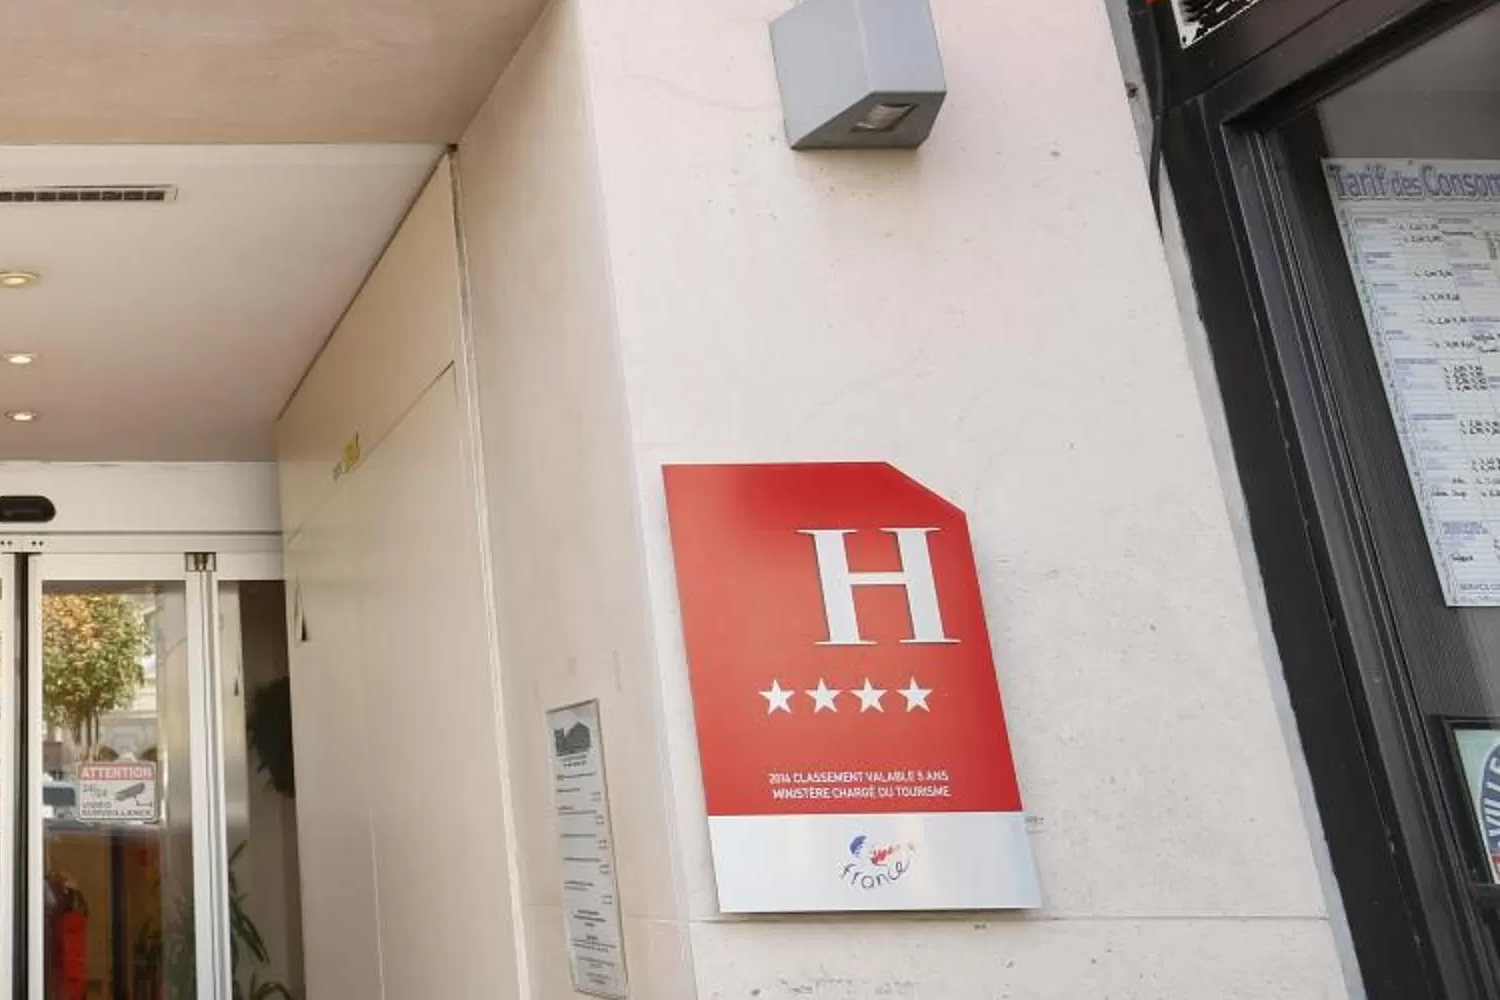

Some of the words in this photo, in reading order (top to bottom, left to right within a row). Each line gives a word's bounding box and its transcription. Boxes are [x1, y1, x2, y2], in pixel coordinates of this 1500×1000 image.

[796, 526, 961, 646] H
[82, 766, 153, 778] ATTENTION
[793, 771, 863, 784] CLASSEMENT
[863, 770, 916, 783] VALABLE
[927, 770, 949, 782] ANS
[877, 786, 894, 798] DU
[896, 785, 951, 798] TOURISME
